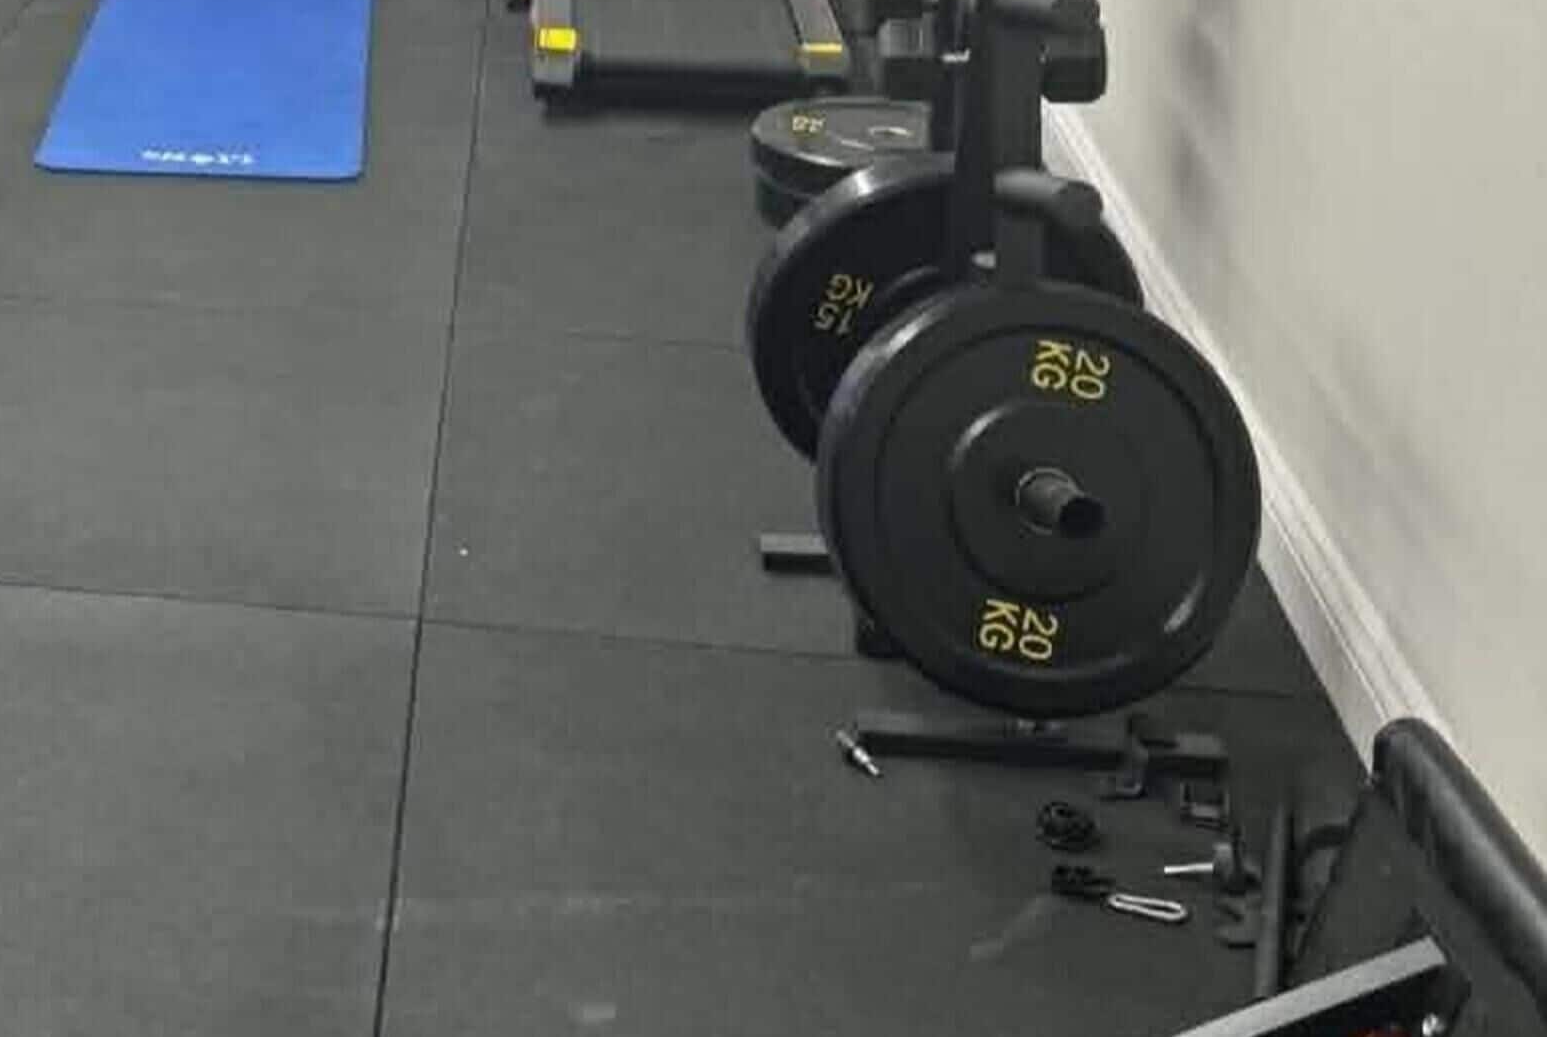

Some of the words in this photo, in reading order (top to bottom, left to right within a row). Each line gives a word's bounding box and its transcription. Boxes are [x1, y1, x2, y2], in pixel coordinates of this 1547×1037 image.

[825, 273, 874, 309] KG
[813, 303, 852, 335] 15
[1030, 339, 1068, 391] KG
[1069, 350, 1110, 401] 20
[979, 597, 1020, 653] KG
[1019, 606, 1060, 660] 20
